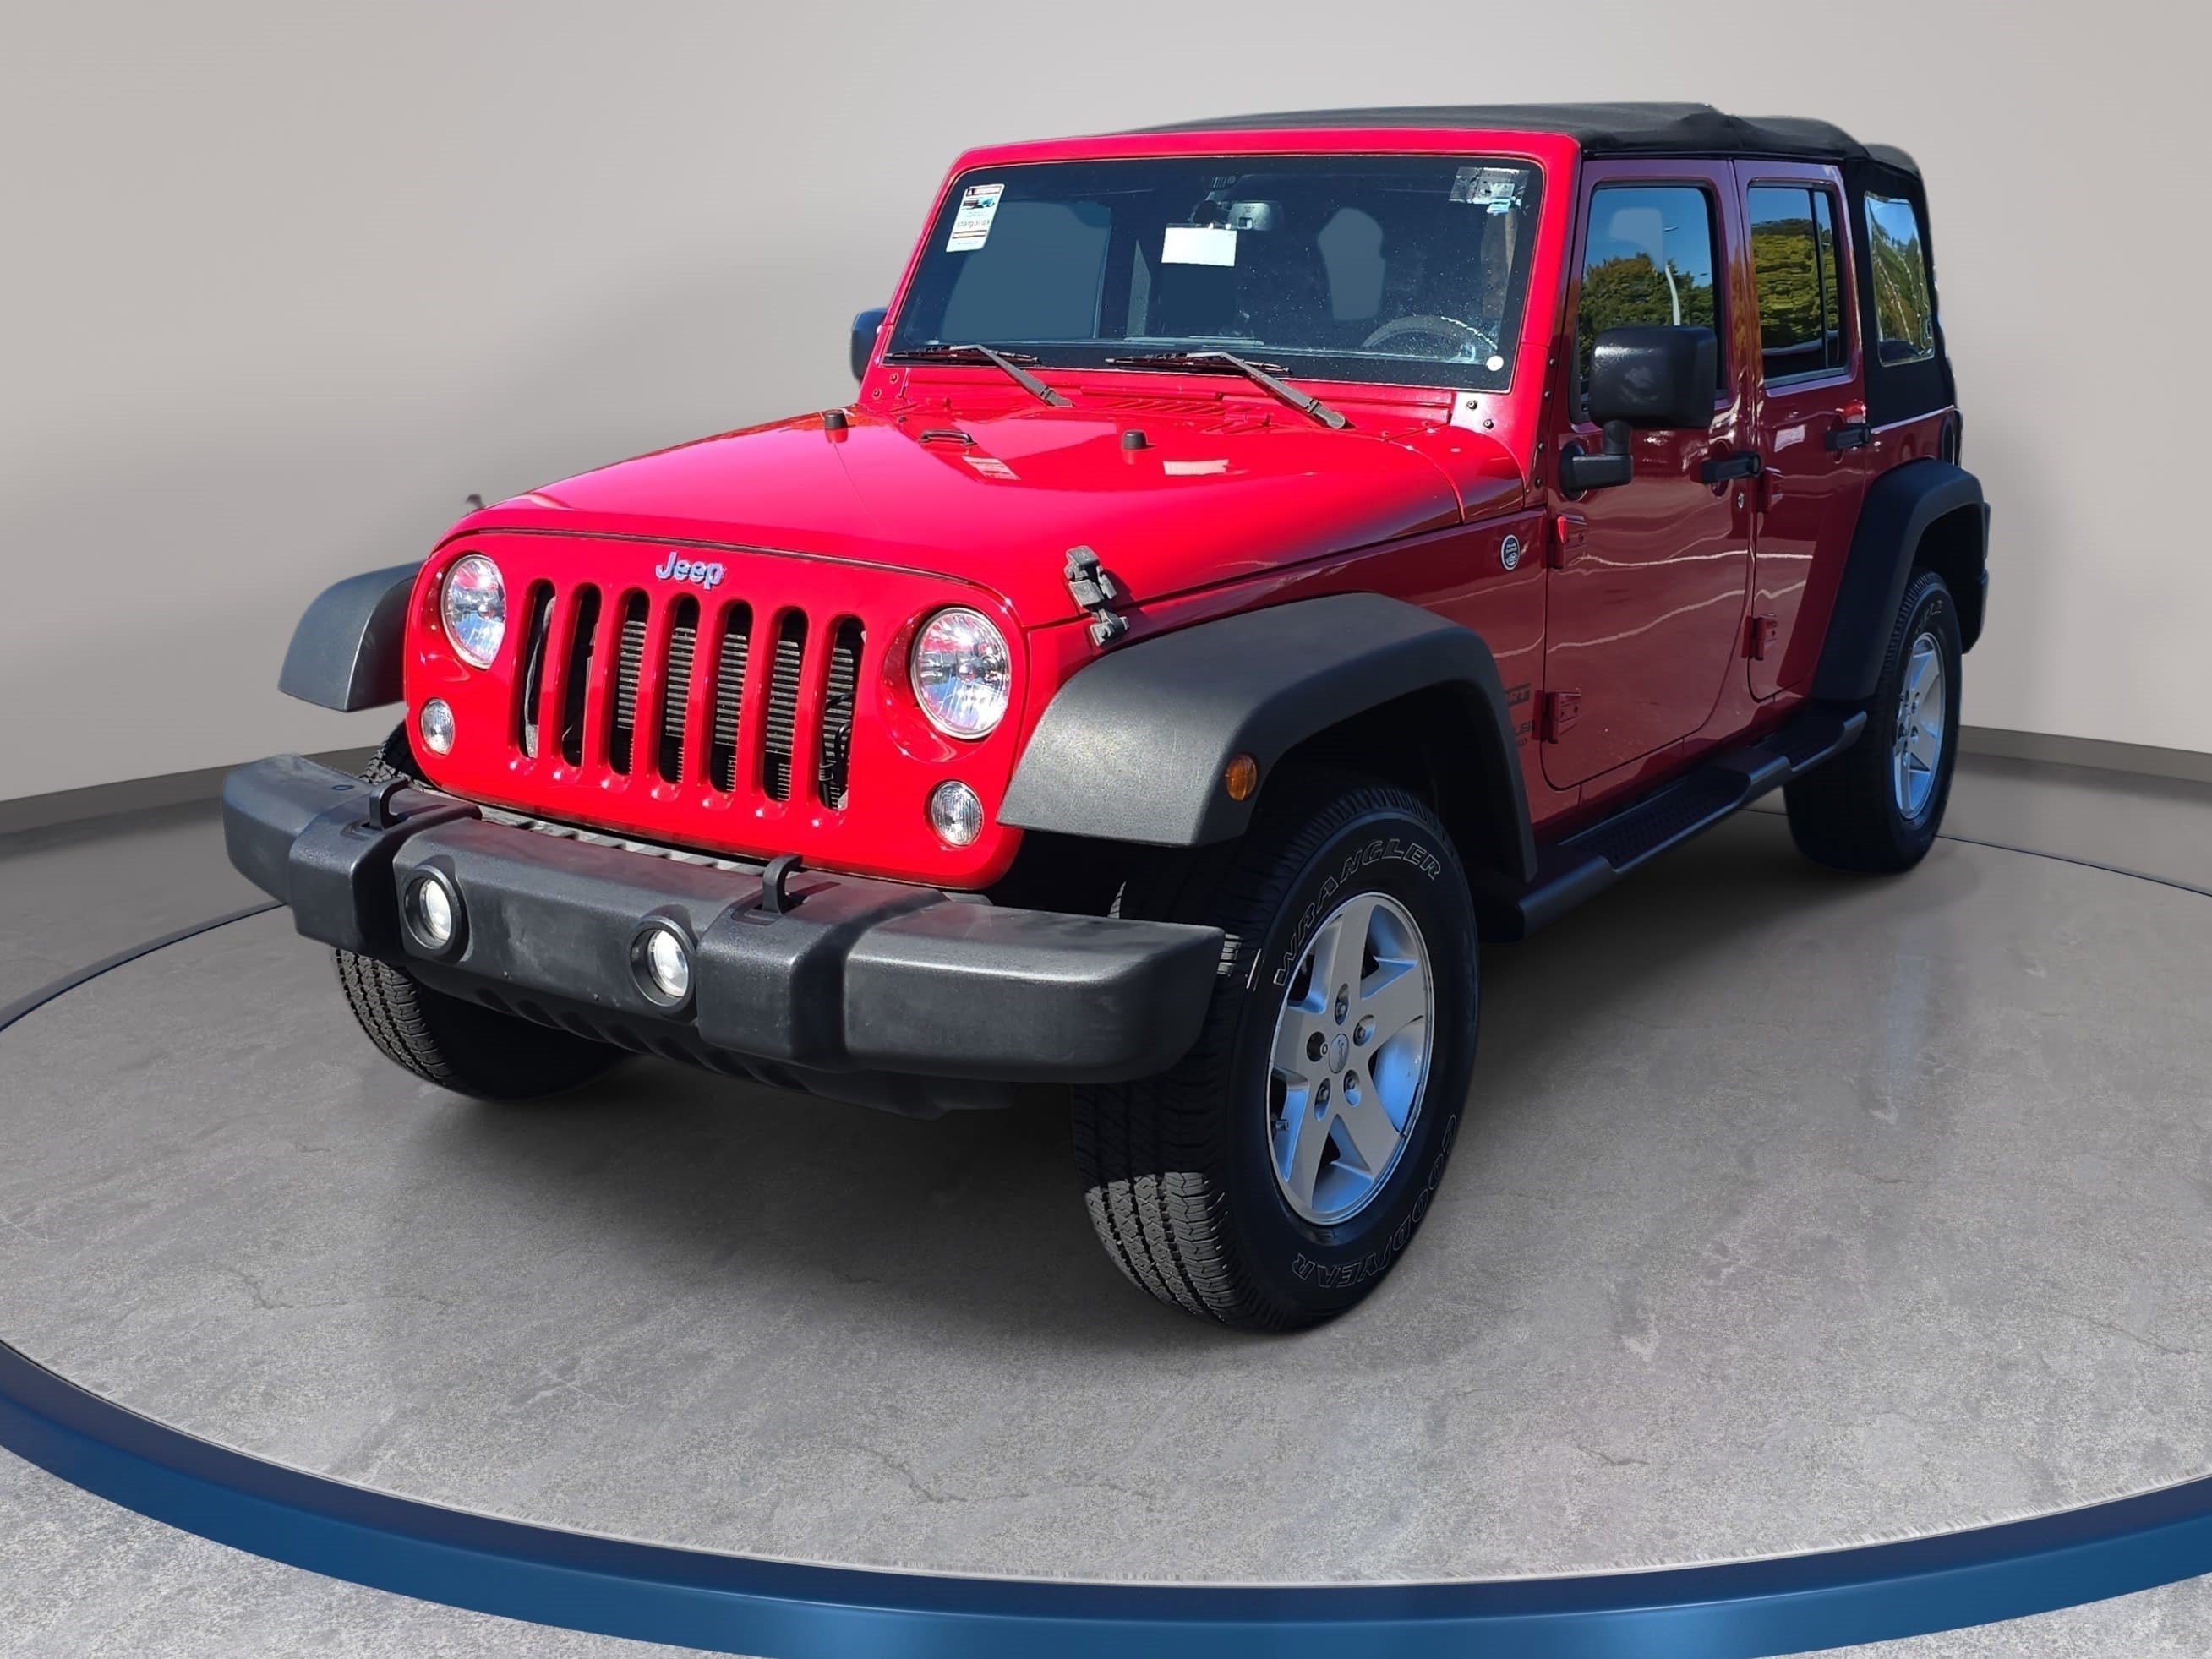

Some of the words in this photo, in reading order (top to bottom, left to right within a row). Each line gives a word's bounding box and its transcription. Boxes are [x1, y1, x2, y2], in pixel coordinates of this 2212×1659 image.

[655, 551, 724, 591] Jeep
[1273, 838, 1441, 986] WRANGLER
[1292, 1114, 1457, 1288] GOODYEAR
